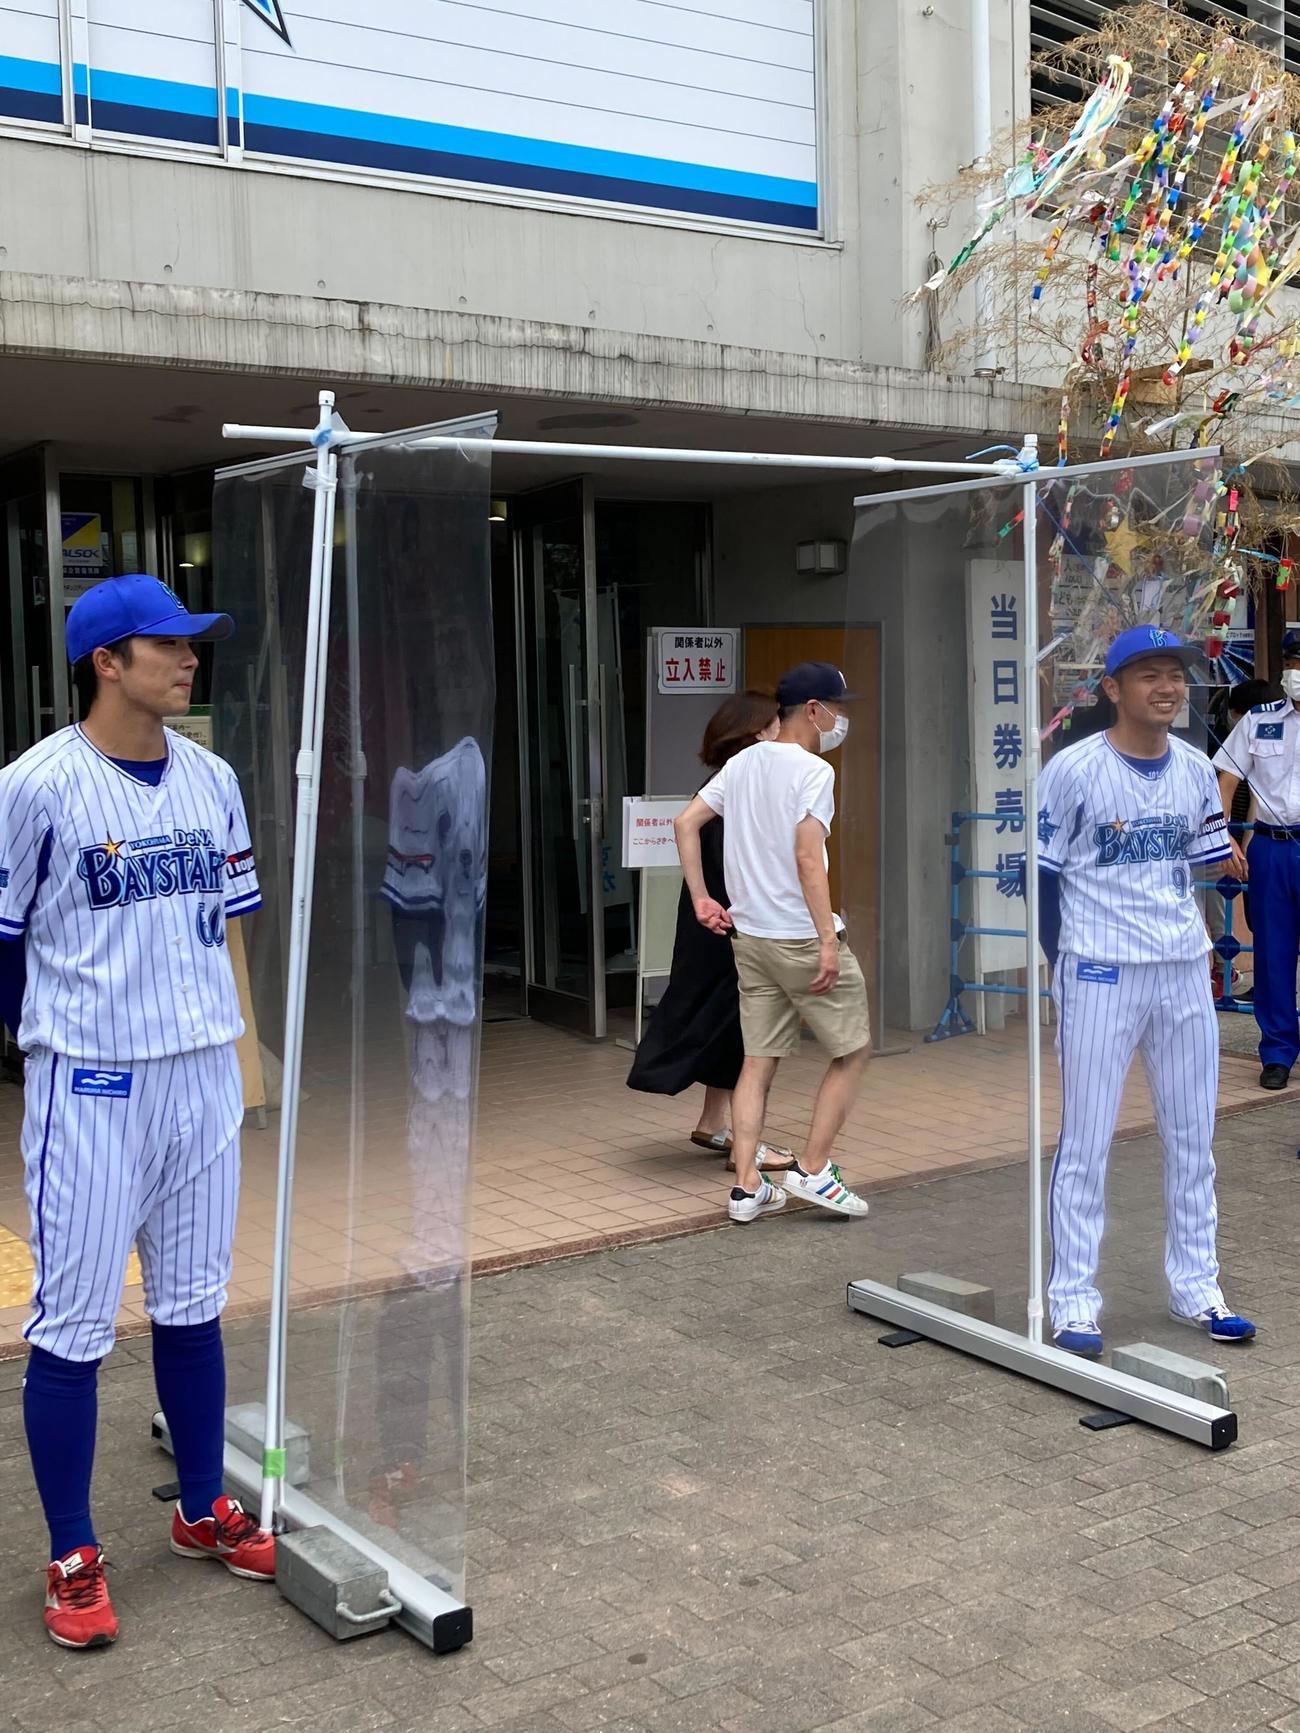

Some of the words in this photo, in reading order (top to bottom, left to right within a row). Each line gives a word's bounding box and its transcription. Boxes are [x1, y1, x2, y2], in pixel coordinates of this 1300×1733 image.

[674, 636, 724, 649] 関係者以外
[665, 658, 726, 682] 立入禁止
[991, 594, 1025, 898] 当日券売場
[636, 818, 673, 827] 関係者以外
[174, 829, 215, 847] DeNA
[633, 837, 675, 845] ここからさきへ
